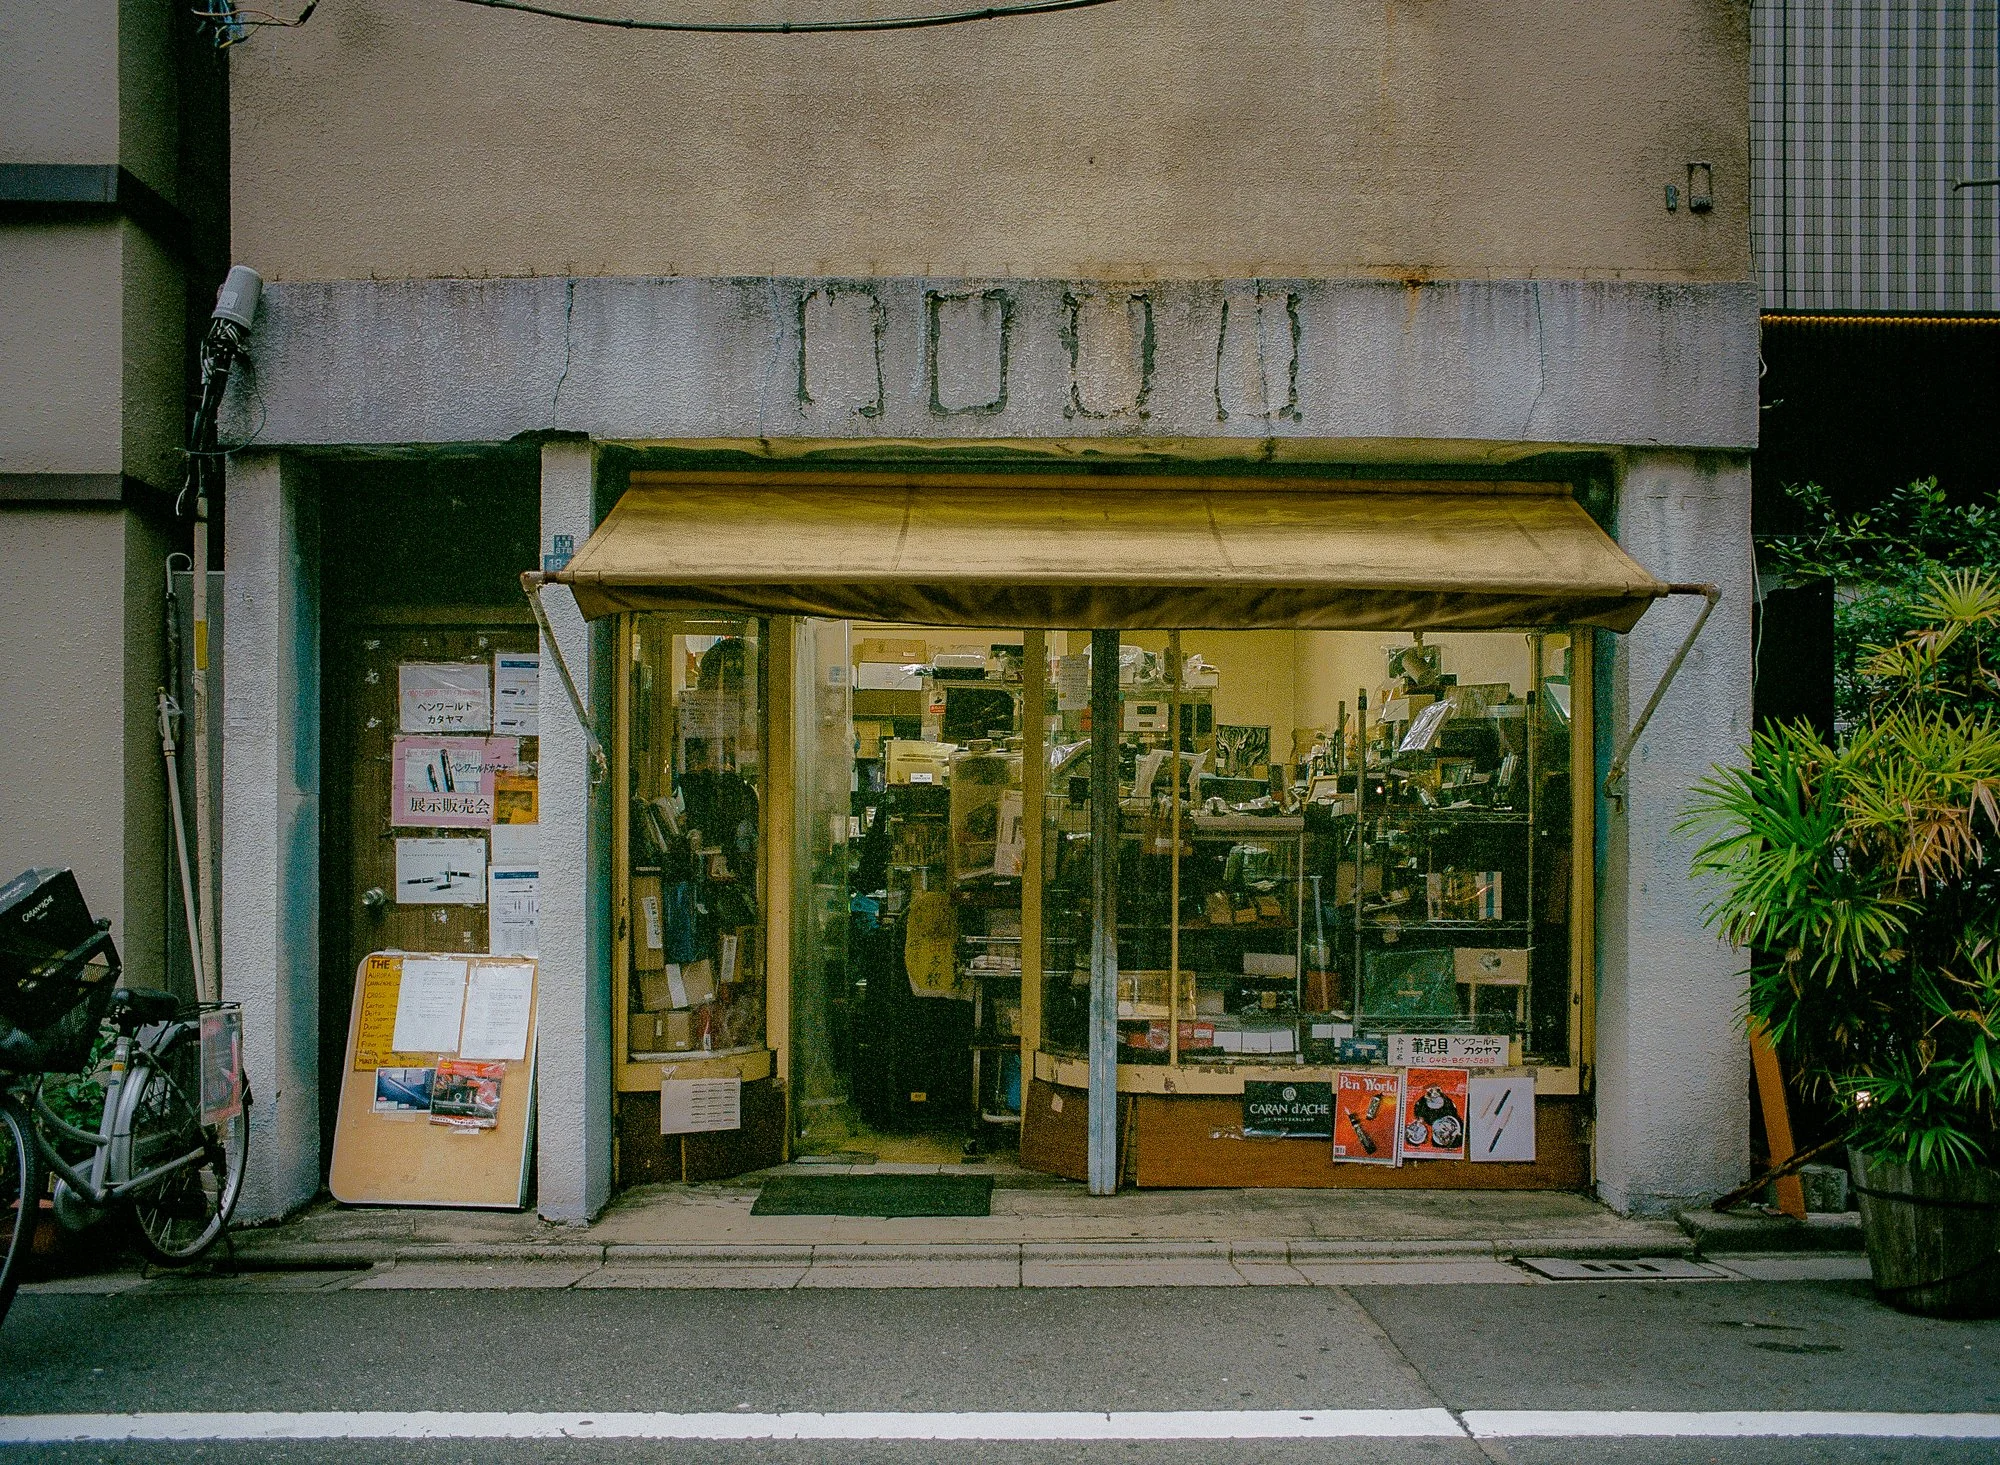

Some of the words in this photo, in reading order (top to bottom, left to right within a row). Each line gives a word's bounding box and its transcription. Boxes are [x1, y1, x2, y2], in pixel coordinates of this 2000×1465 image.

[427, 714, 464, 725] カタヤマ
[410, 796, 491, 815] 展示販売会
[370, 959, 391, 970] THE
[1411, 1037, 1449, 1054] 筆記具
[1453, 1037, 1499, 1046] ペンワールド
[1463, 1046, 1502, 1055] カタヤマ
[1411, 1056, 1426, 1064] TEL
[1340, 1075, 1360, 1090] Pen
[1362, 1077, 1398, 1093] World
[1249, 1103, 1289, 1115] CARAN
[1291, 1103, 1330, 1115] d'ACHE
